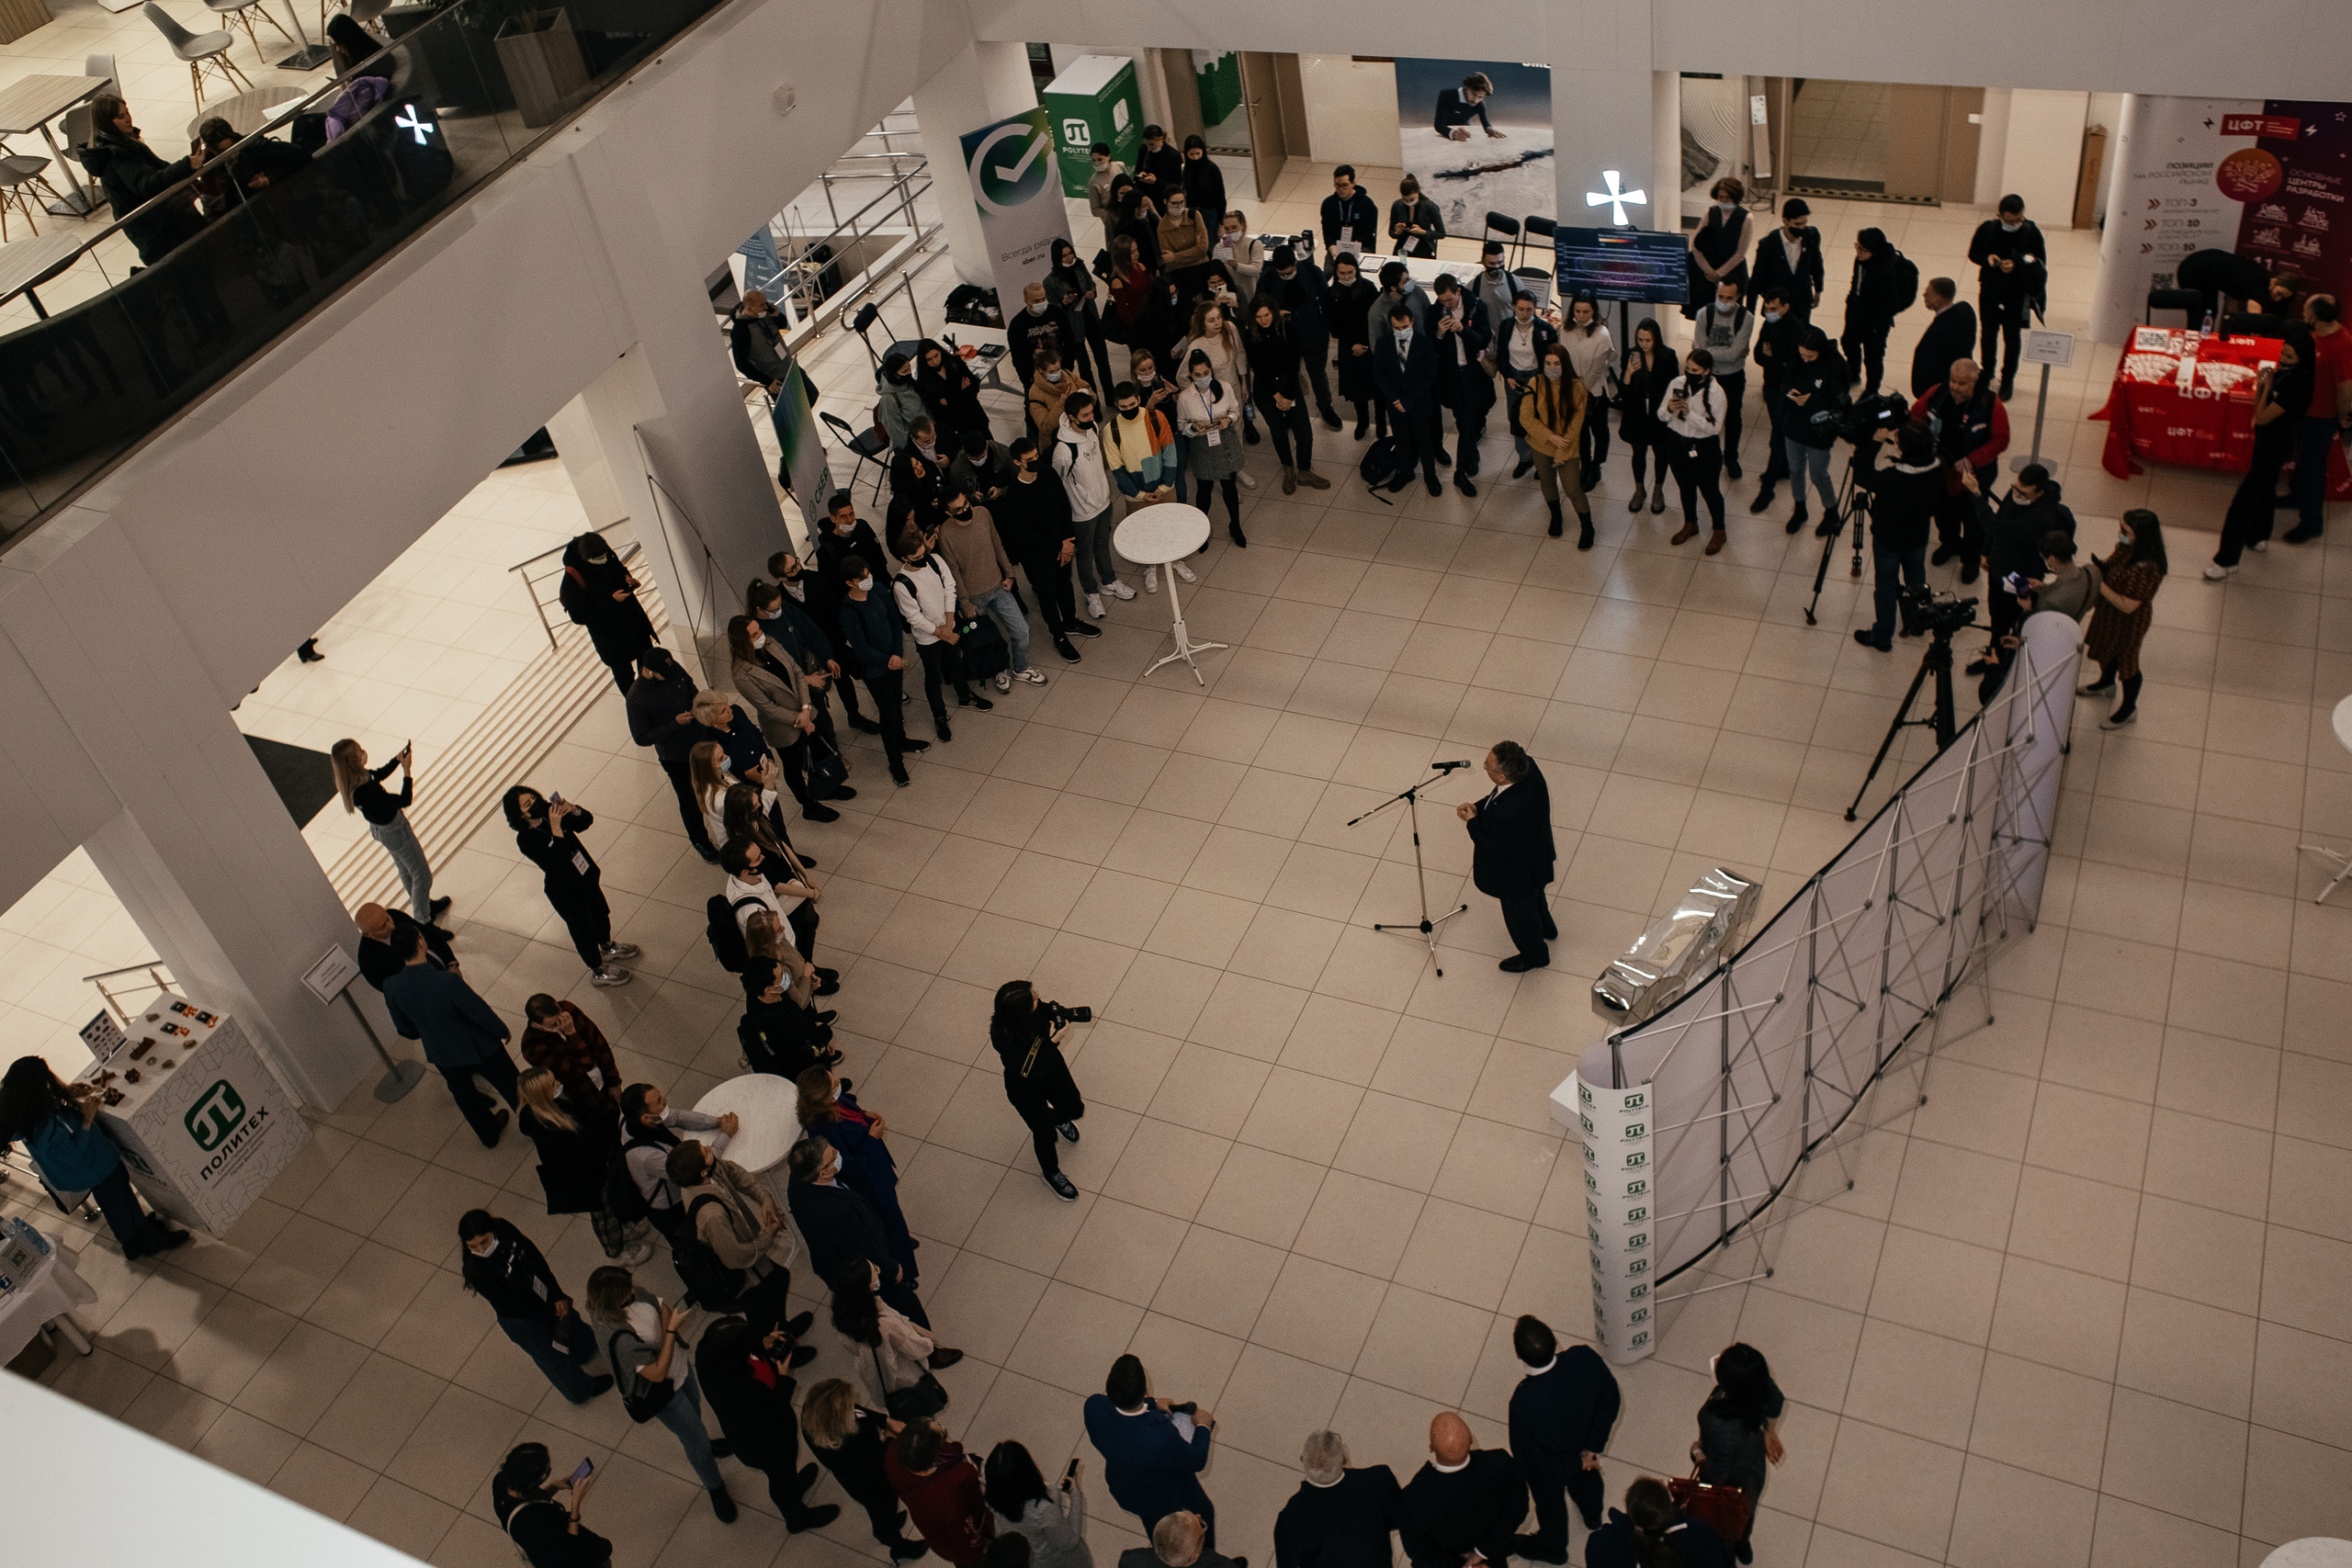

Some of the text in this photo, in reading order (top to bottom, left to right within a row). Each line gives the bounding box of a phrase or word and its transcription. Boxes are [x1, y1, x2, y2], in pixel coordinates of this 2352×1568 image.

[2228, 119, 2265, 131] ЦФТ
[1062, 146, 1091, 155] POLYTE
[2290, 168, 2343, 185] ОСНОВНЫЕ
[2288, 177, 2327, 190] ЦЕНТРЫ
[2286, 185, 2345, 203] РАЗРАБОТКИ
[1001, 245, 1032, 262] Всегда
[1023, 254, 1046, 265] sber.ru
[2166, 426, 2194, 437] ЦФТ
[815, 467, 829, 504] СБЕР
[1619, 1104, 1649, 1113] POLYTECH
[200, 1105, 269, 1181] ПОЛИТЕХ
[1620, 1134, 1650, 1143] POLYTECH
[1622, 1162, 1650, 1171] POLYTECH
